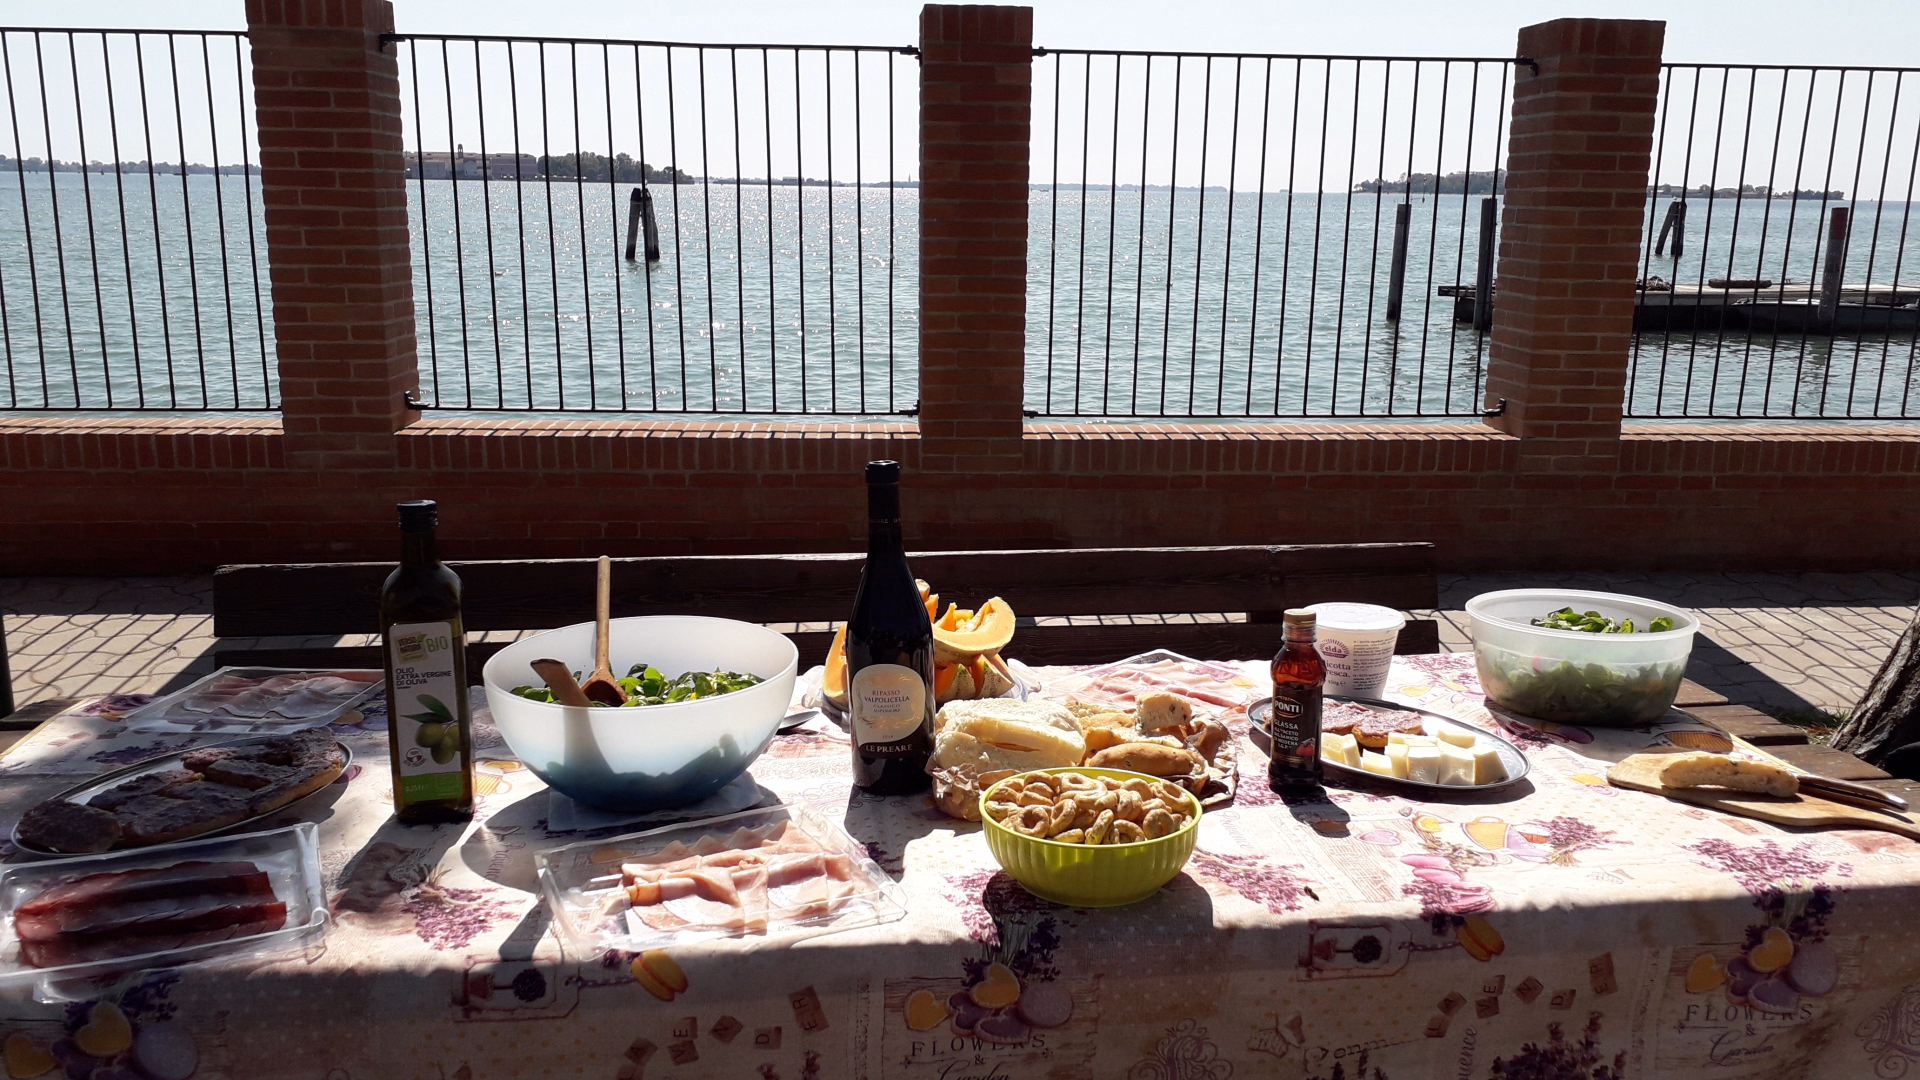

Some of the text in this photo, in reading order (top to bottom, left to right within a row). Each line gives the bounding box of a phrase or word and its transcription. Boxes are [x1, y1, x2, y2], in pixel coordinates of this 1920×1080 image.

[426, 636, 448, 652] BIO
[395, 667, 415, 675] OLIO
[1326, 660, 1351, 671] icotta
[396, 670, 452, 681] EXTRA VERGINE
[1326, 669, 1351, 678] resca.
[406, 678, 428, 686] OLIVA
[864, 695, 910, 703] VALPOLICELLA
[1274, 700, 1299, 713] PONTI
[1274, 718, 1299, 730] GLASSA
[865, 743, 912, 753] LE PREARE
[1746, 1023, 1757, 1036] &
[974, 1053, 986, 1065] &
